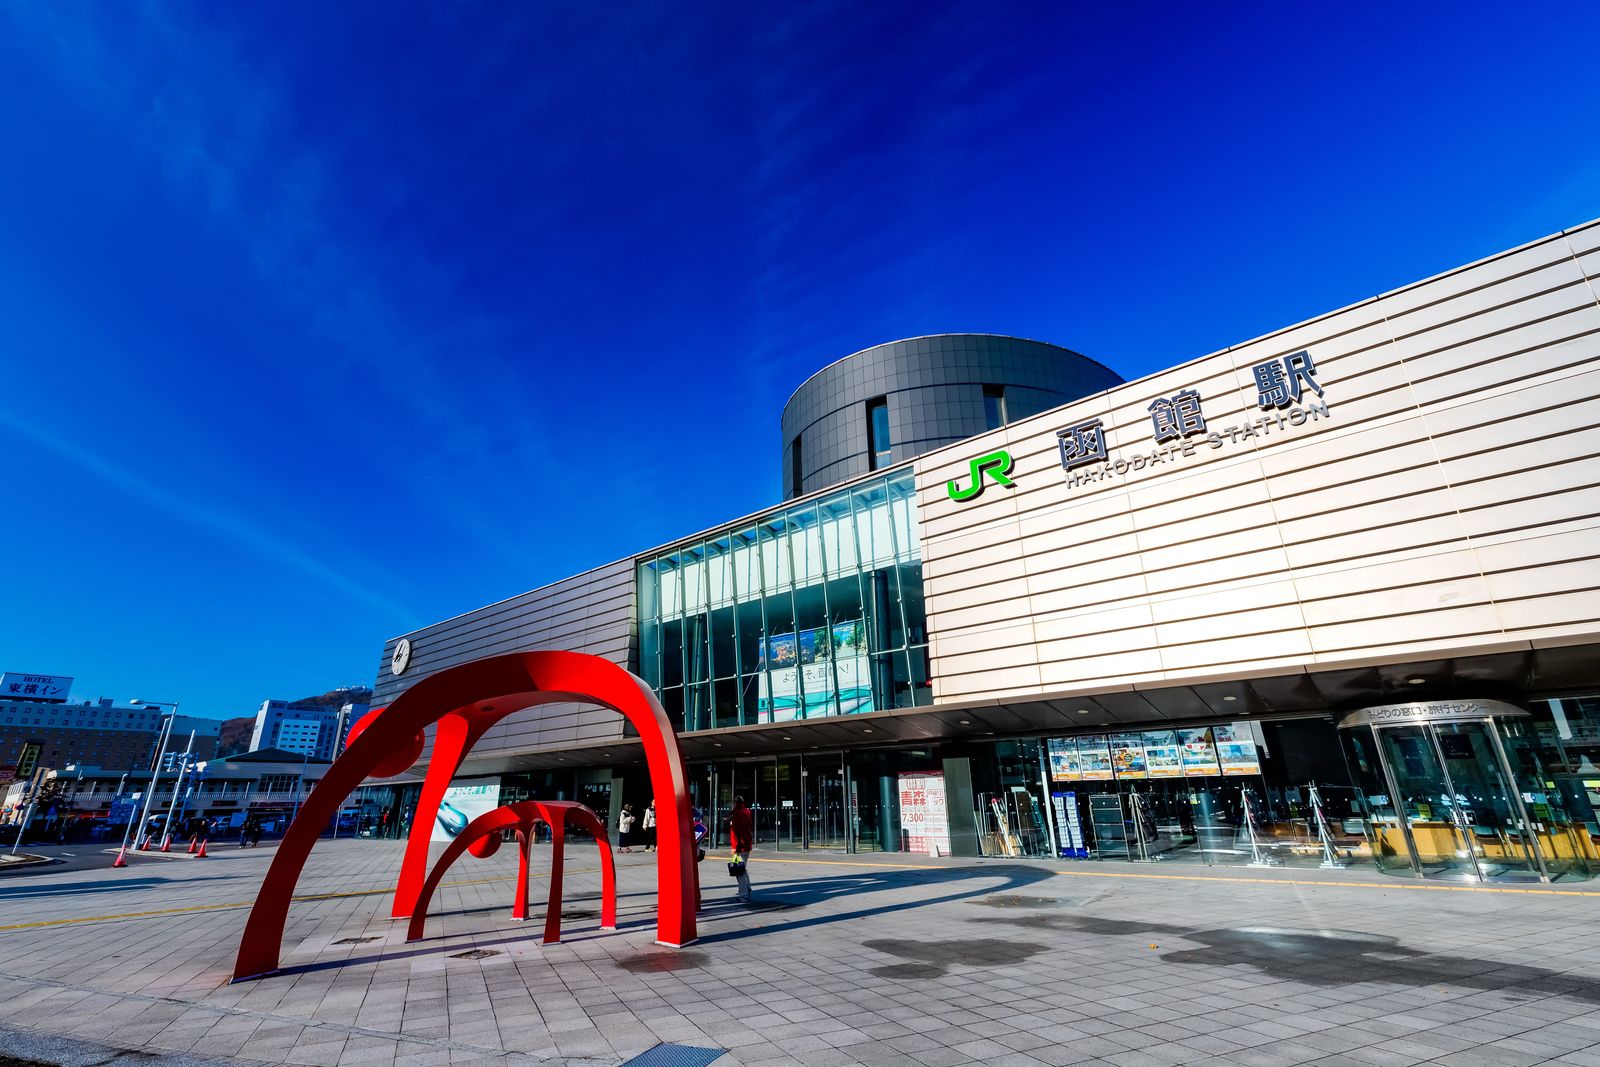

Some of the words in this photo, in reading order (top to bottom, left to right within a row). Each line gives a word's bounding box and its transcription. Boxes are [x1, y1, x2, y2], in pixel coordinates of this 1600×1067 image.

[1064, 440, 1196, 489] HAKODATE
[1208, 401, 1330, 449] STATION
[947, 450, 1015, 501] JR
[23, 676, 54, 684] HOTEL
[9, 684, 62, 695] 東横イン
[900, 790, 927, 806] 青森
